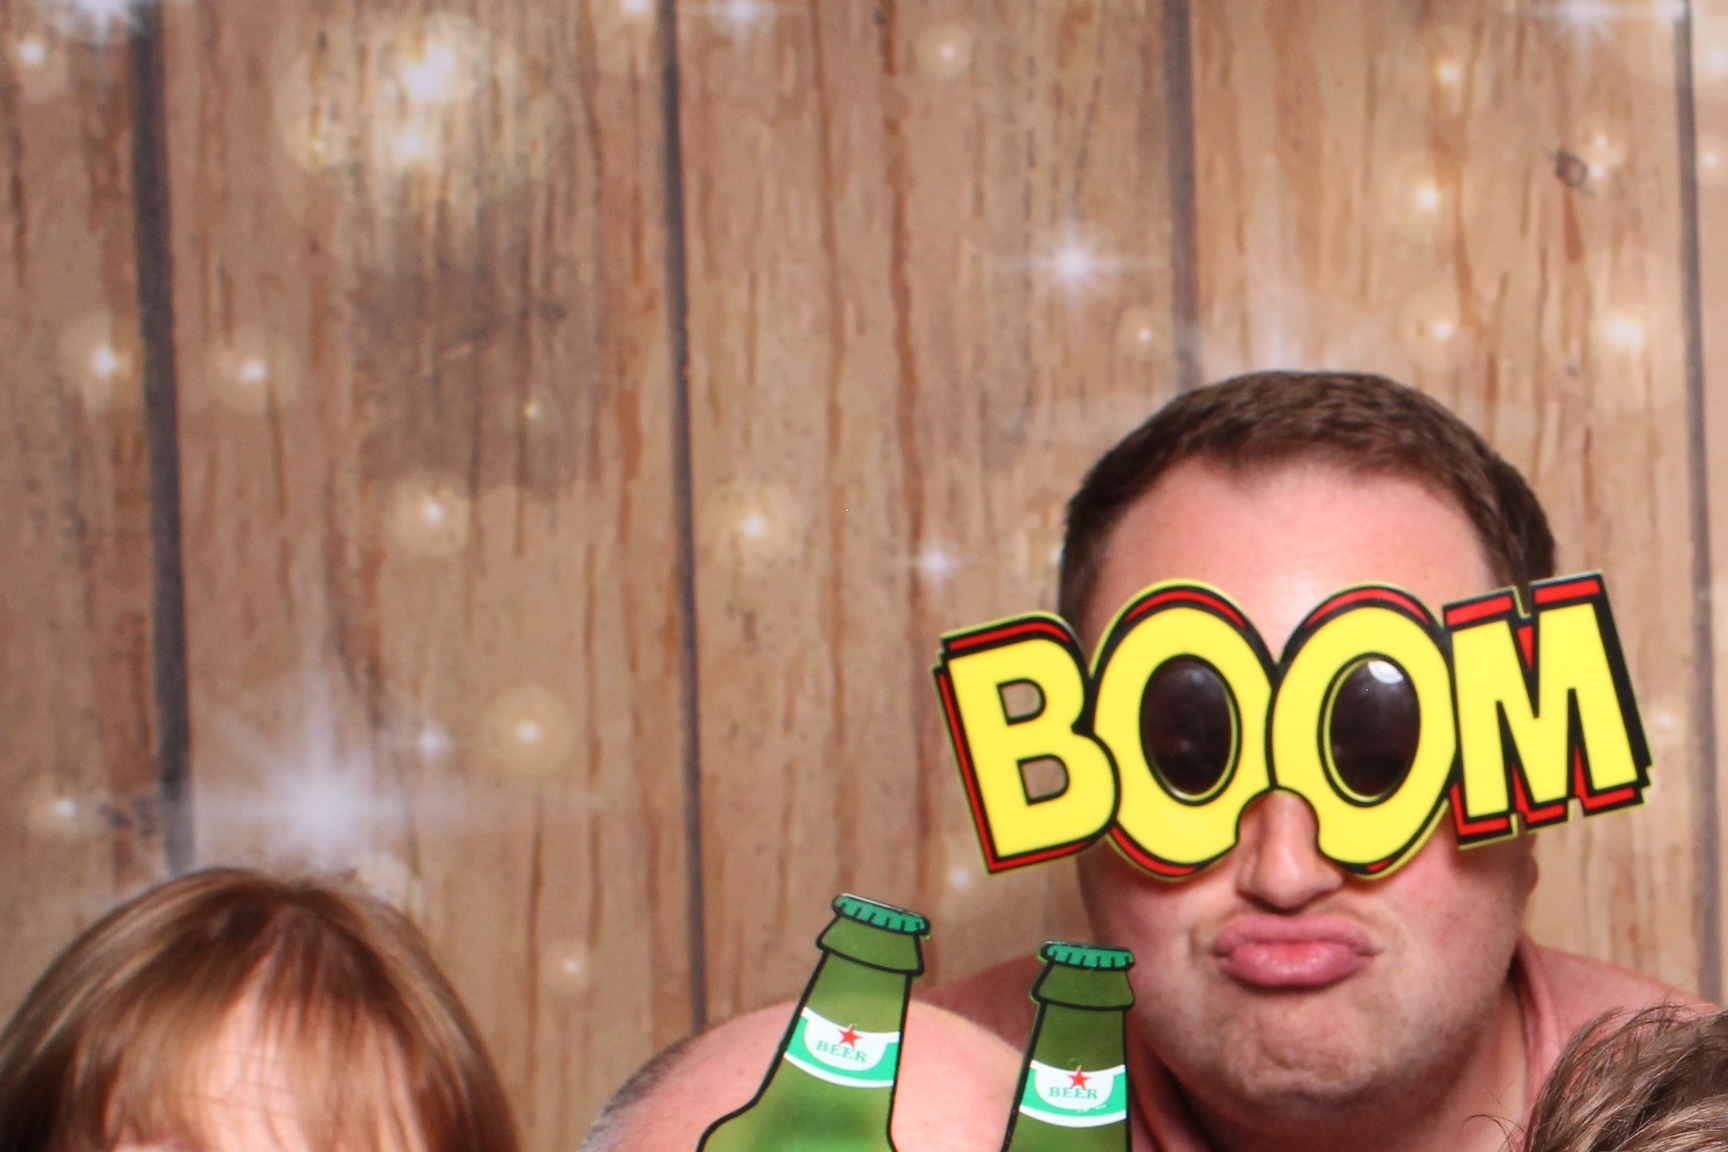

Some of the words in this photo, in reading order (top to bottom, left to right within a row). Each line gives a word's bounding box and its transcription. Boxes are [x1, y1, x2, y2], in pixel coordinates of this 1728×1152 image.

[932, 572, 1652, 881] BOOM
[815, 1040, 868, 1063] BEER
[1048, 1086, 1099, 1099] BEER
